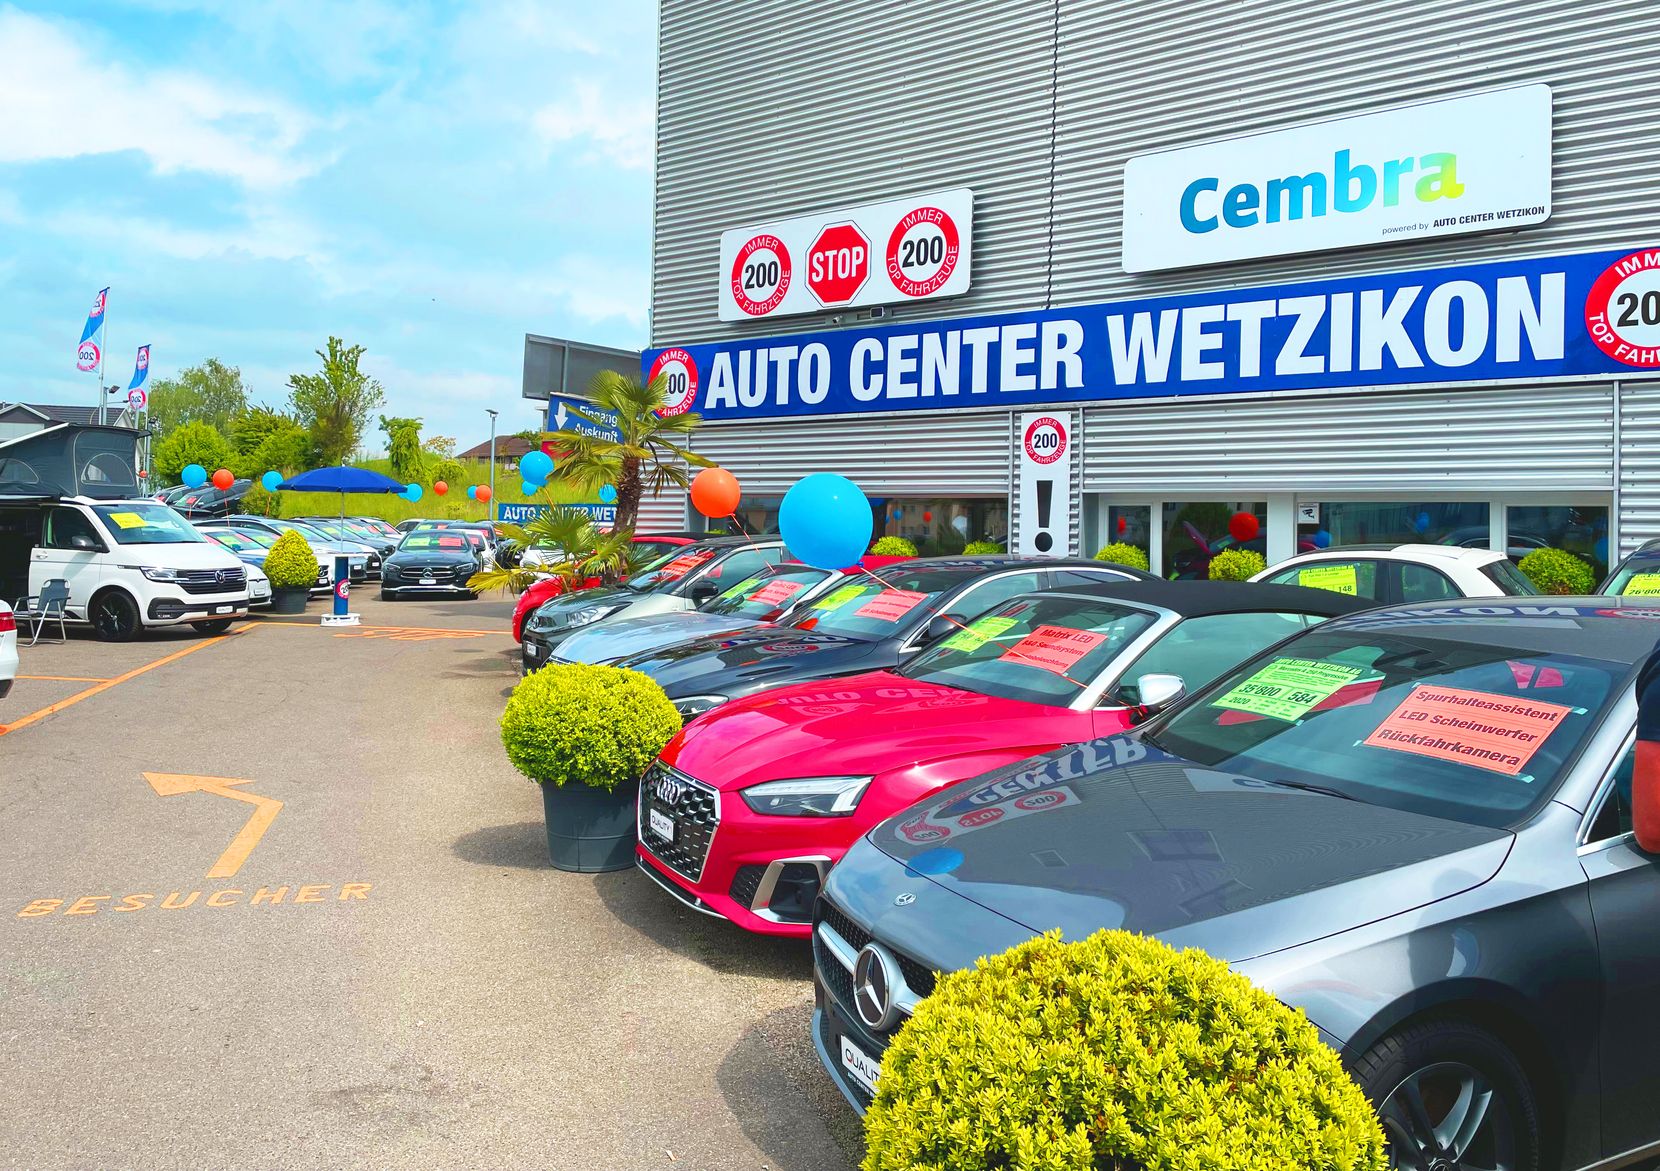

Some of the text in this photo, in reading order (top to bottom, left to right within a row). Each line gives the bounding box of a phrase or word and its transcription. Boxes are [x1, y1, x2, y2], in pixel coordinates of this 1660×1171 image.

[1179, 148, 1465, 233] Cembra
[903, 208, 943, 230] IMMER
[1382, 206, 1545, 235] powered by AUTO CENTER WETZIKON
[744, 236, 779, 255] IMMER
[902, 235, 943, 268] 200
[744, 260, 779, 290] 200
[811, 246, 865, 283] STOP
[887, 245, 958, 296] TOP FAHRZEUGE
[1615, 252, 1660, 278] IMM
[732, 269, 791, 315] TOP FAHRZEUGE
[1617, 290, 1660, 327] 20
[704, 271, 1566, 409] AUTO CENTER WETZIKON
[1589, 312, 1615, 344] TOP
[660, 350, 689, 365] IMMER
[658, 381, 697, 417] AHRZEUGE
[665, 372, 687, 394] 00
[1034, 419, 1057, 429] IMMER
[1025, 440, 1034, 455] TOP
[1033, 433, 1058, 448] 200
[1040, 629, 1094, 644] Matrix LED
[1238, 684, 1318, 704] 35'800 584
[1416, 690, 1559, 722] Spurhalteassistent
[1398, 710, 1538, 743] LED Scheinwerfer
[1377, 729, 1521, 766] Rückfahrkamera
[16, 882, 373, 919] BESUCHER
[845, 1048, 880, 1081] QUALIT
